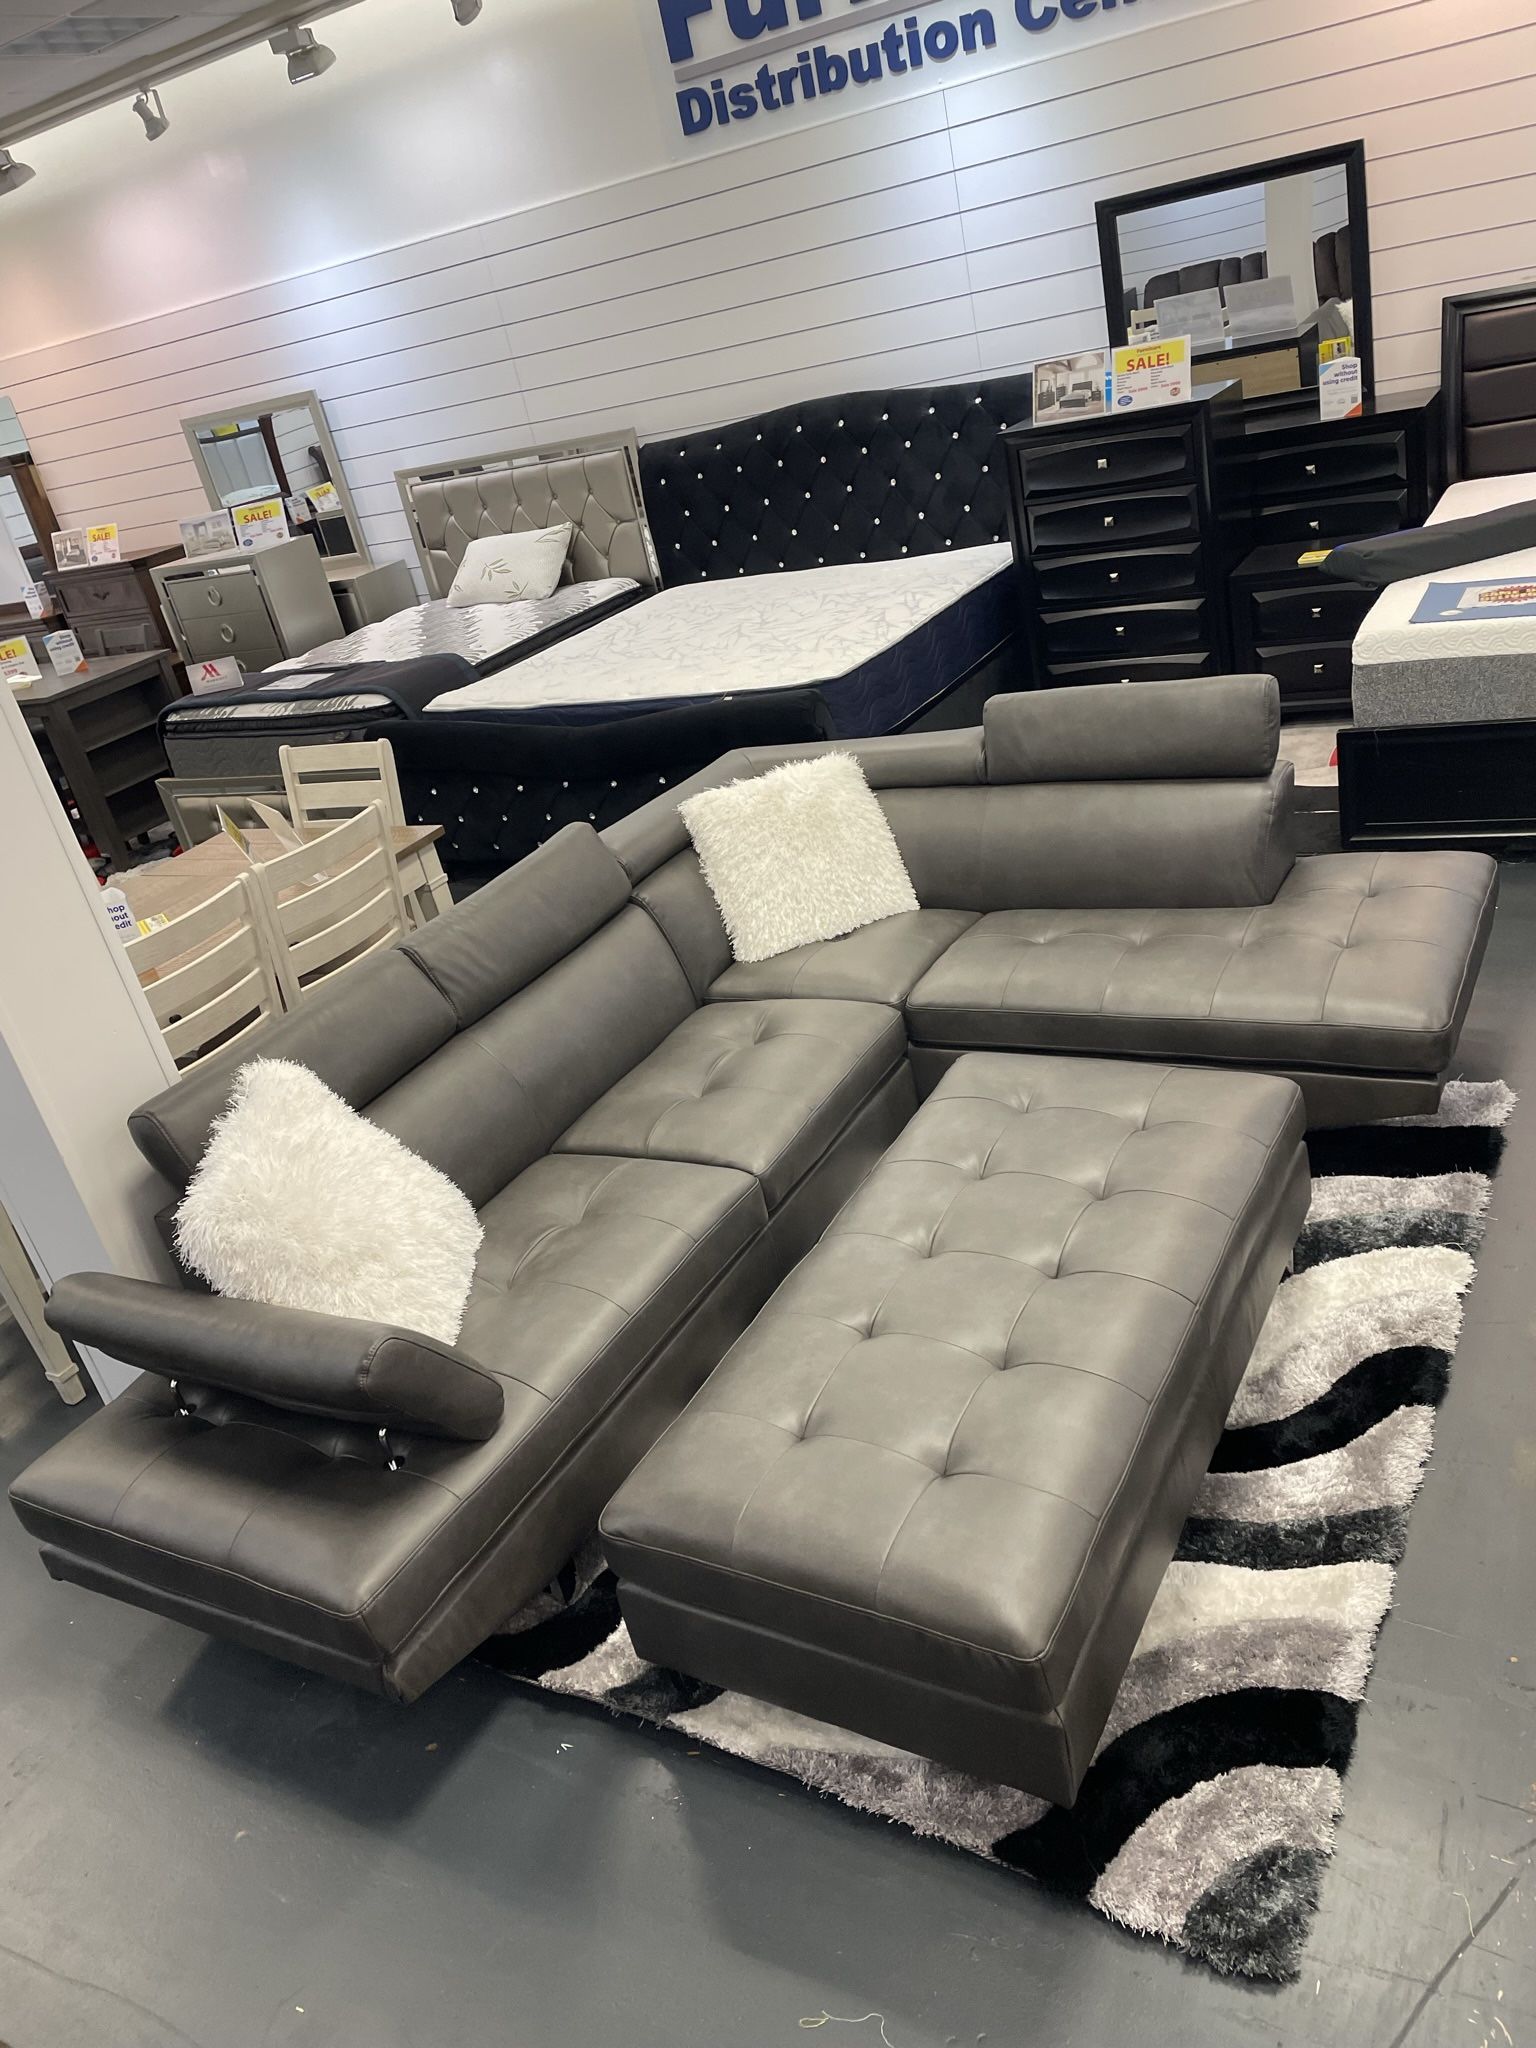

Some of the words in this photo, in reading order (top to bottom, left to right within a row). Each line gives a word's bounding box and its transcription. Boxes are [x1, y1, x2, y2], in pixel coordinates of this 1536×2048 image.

[675, 7, 997, 136] Distribution
[1014, 0, 1137, 31] Ce
[1126, 352, 1169, 372] SALE!
[1334, 369, 1357, 377] without
[1340, 375, 1357, 383] credit
[243, 509, 272, 524] SALE!
[106, 905, 125, 914] hop
[115, 920, 132, 930] edit
